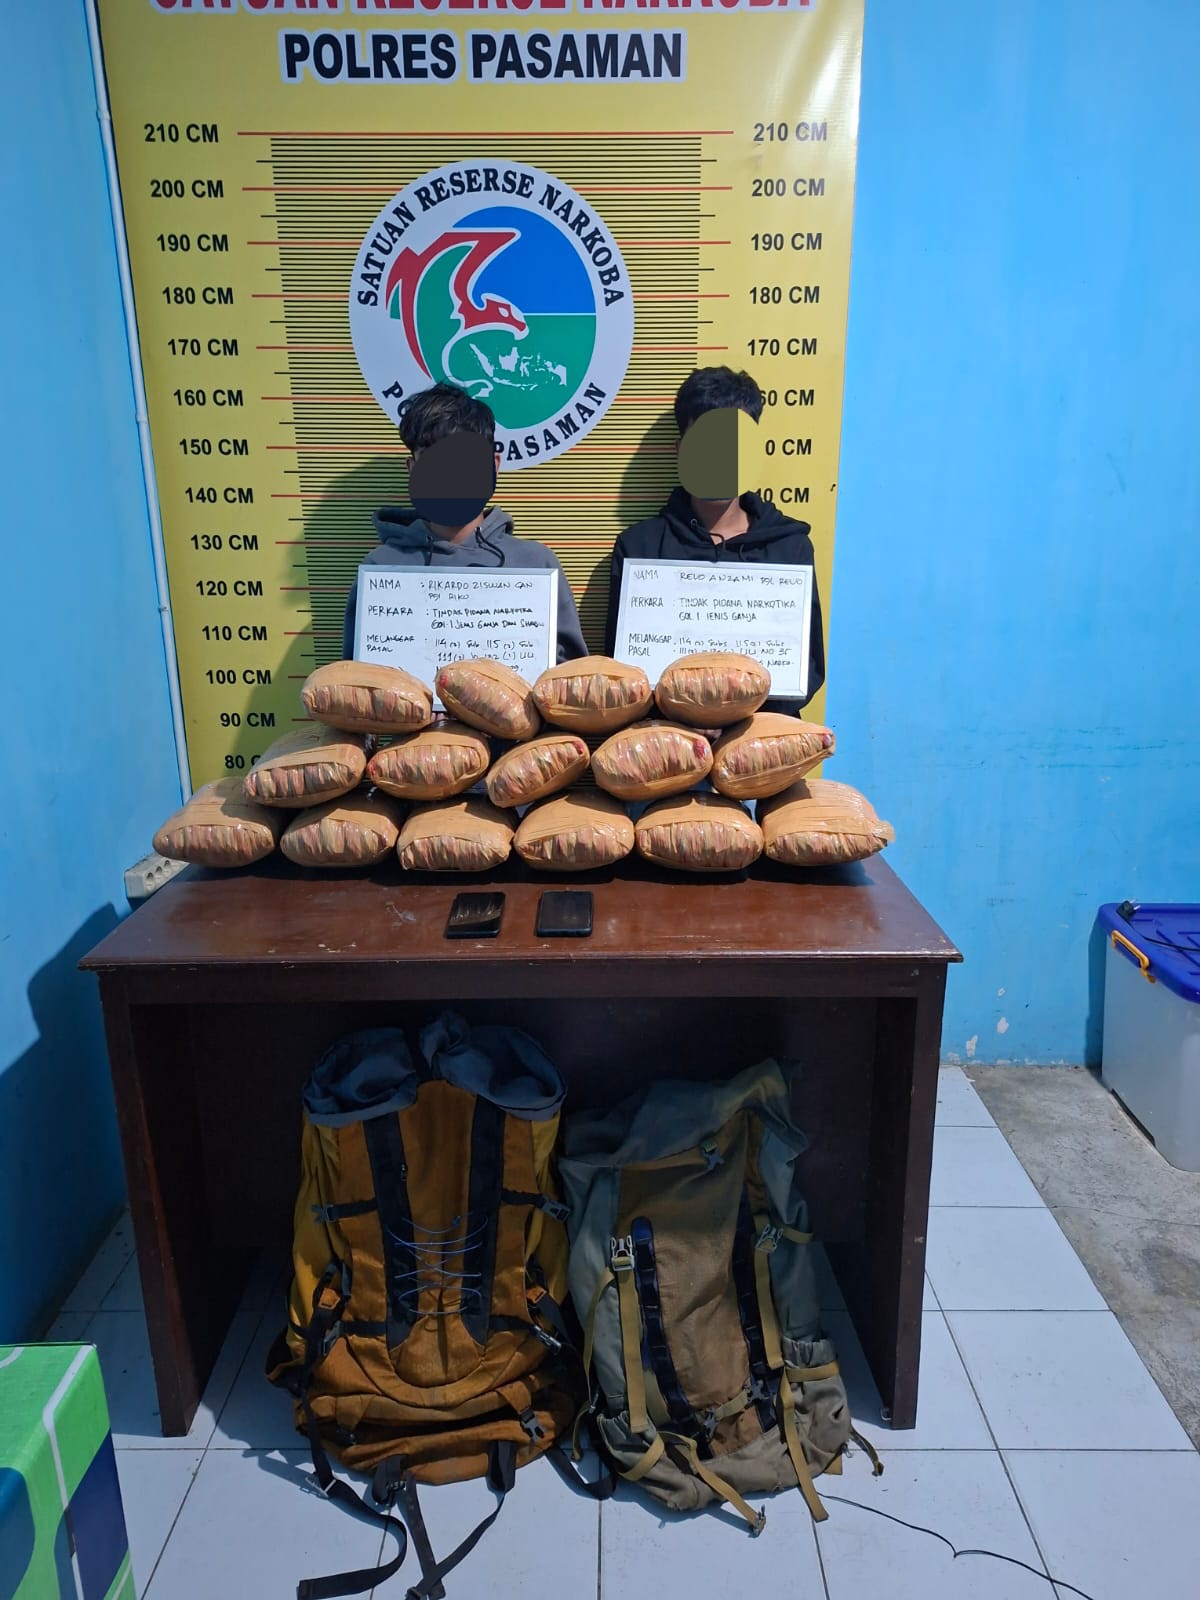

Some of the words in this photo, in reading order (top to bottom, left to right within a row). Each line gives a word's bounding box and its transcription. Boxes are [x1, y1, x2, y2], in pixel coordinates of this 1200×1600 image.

[285, 34, 456, 78] POLRES
[472, 34, 681, 78] PASAMAN
[144, 124, 179, 142] 210
[186, 124, 218, 142] CM
[754, 123, 788, 141] 210
[795, 123, 828, 141] CM
[150, 180, 184, 198] 200
[192, 180, 223, 198] CM
[752, 179, 786, 196] 200
[794, 179, 824, 196] CM
[157, 234, 190, 251] 190
[197, 234, 228, 251] CM
[357, 201, 416, 306] SATUAN
[414, 168, 535, 212] RESERSE
[538, 184, 624, 307] NARKOBA
[751, 233, 784, 251] 190
[791, 233, 822, 251] CM
[163, 287, 195, 304] 180
[203, 287, 233, 304] CM
[750, 286, 781, 304] 180
[789, 286, 819, 304] CM
[168, 339, 200, 356] 170
[208, 339, 238, 356] CM
[748, 338, 779, 356] 170
[787, 338, 817, 356] CM
[174, 389, 206, 406] 160
[213, 389, 243, 406] CM
[785, 389, 814, 406] CM
[494, 382, 607, 461] PASAMAN
[180, 439, 211, 455] 150
[218, 439, 248, 455] CM
[782, 439, 811, 455] CM
[185, 488, 217, 503] 140
[224, 488, 253, 503] CM
[780, 488, 809, 504] CM
[191, 535, 222, 550] 130
[229, 535, 258, 550] CM
[196, 581, 227, 596] 120
[234, 581, 263, 596] CM
[369, 578, 401, 590] NAMA
[428, 580, 469, 590] RIKARDO
[631, 597, 664, 608] PERKARA
[747, 600, 796, 609] NARKOTIKA
[368, 606, 414, 617] PERKARA
[732, 612, 757, 622] GANJA
[202, 626, 232, 640] 110
[238, 626, 267, 640] CM
[366, 644, 393, 654] PASAL
[628, 645, 651, 656] PASAL
[206, 670, 236, 684] 100
[243, 670, 272, 684] CM
[221, 713, 240, 727] 90
[247, 713, 275, 727] CM
[225, 755, 244, 769] 80
